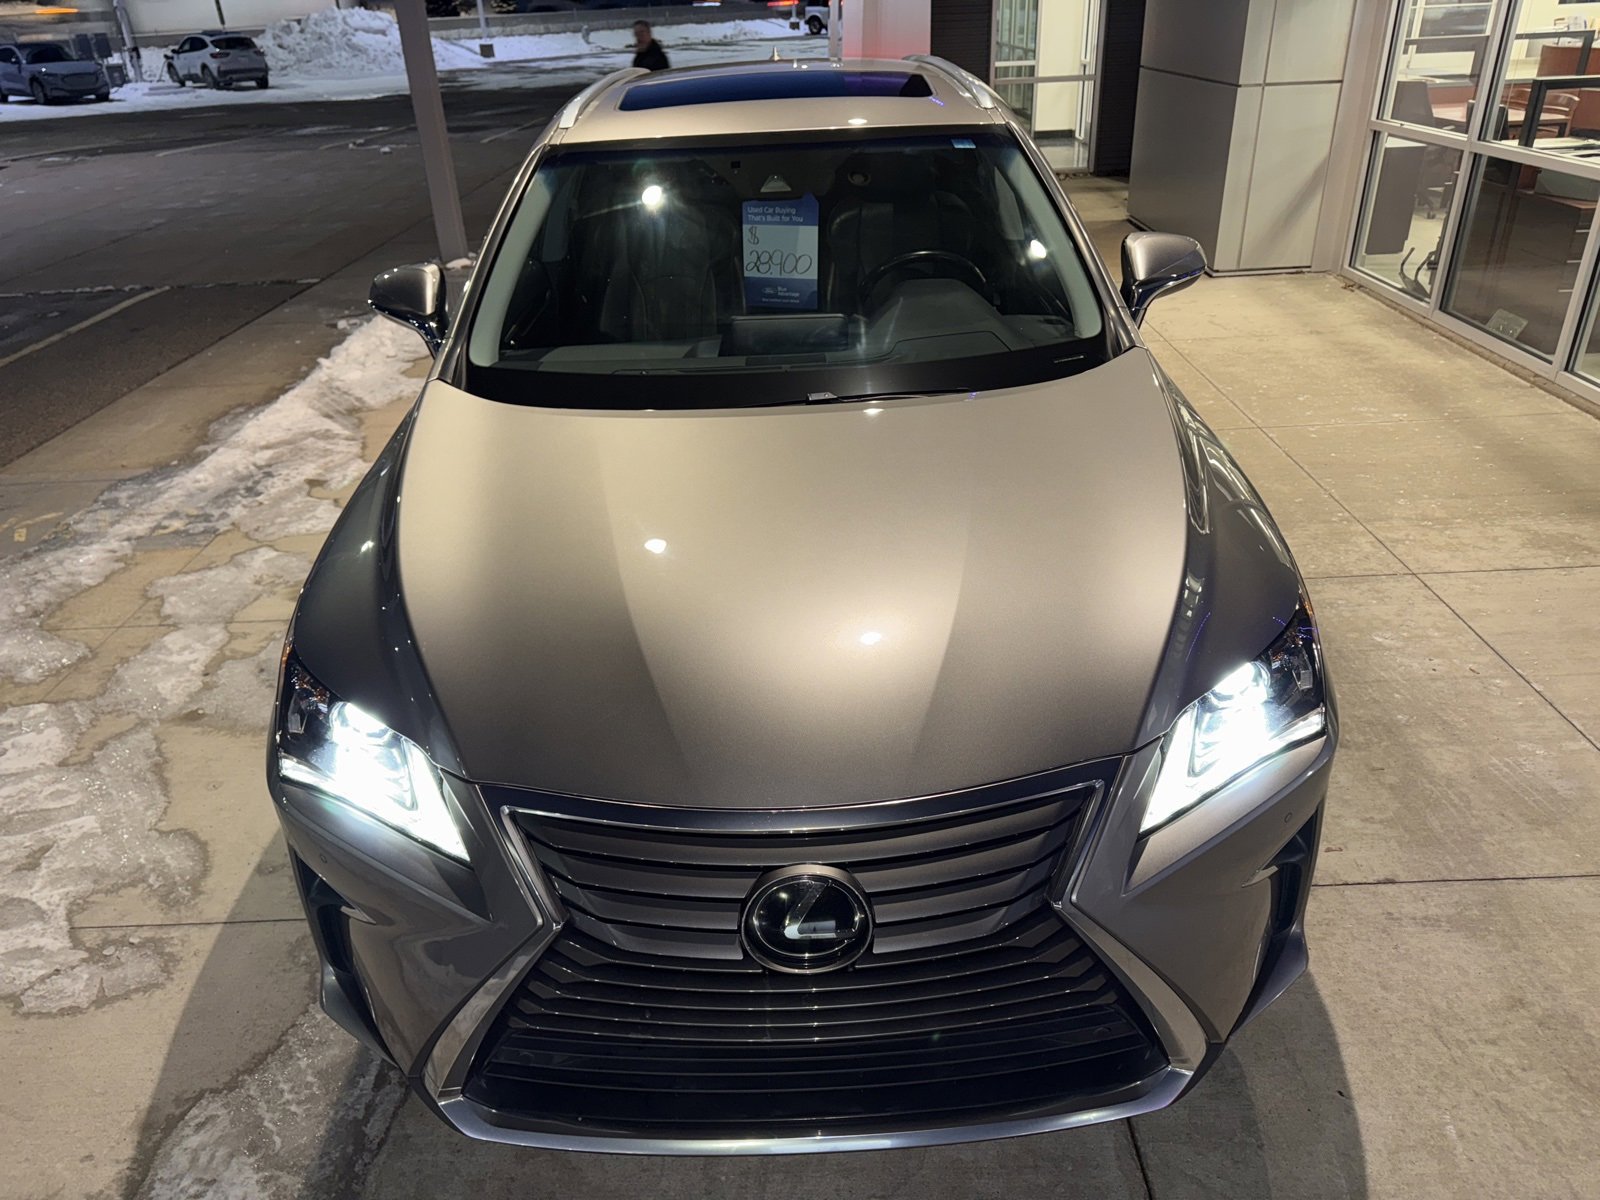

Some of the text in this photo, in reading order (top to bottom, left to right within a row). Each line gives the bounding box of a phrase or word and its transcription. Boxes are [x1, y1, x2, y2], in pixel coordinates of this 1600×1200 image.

[766, 214, 780, 222] Built
[781, 214, 790, 222] for
[747, 226, 760, 245] $
